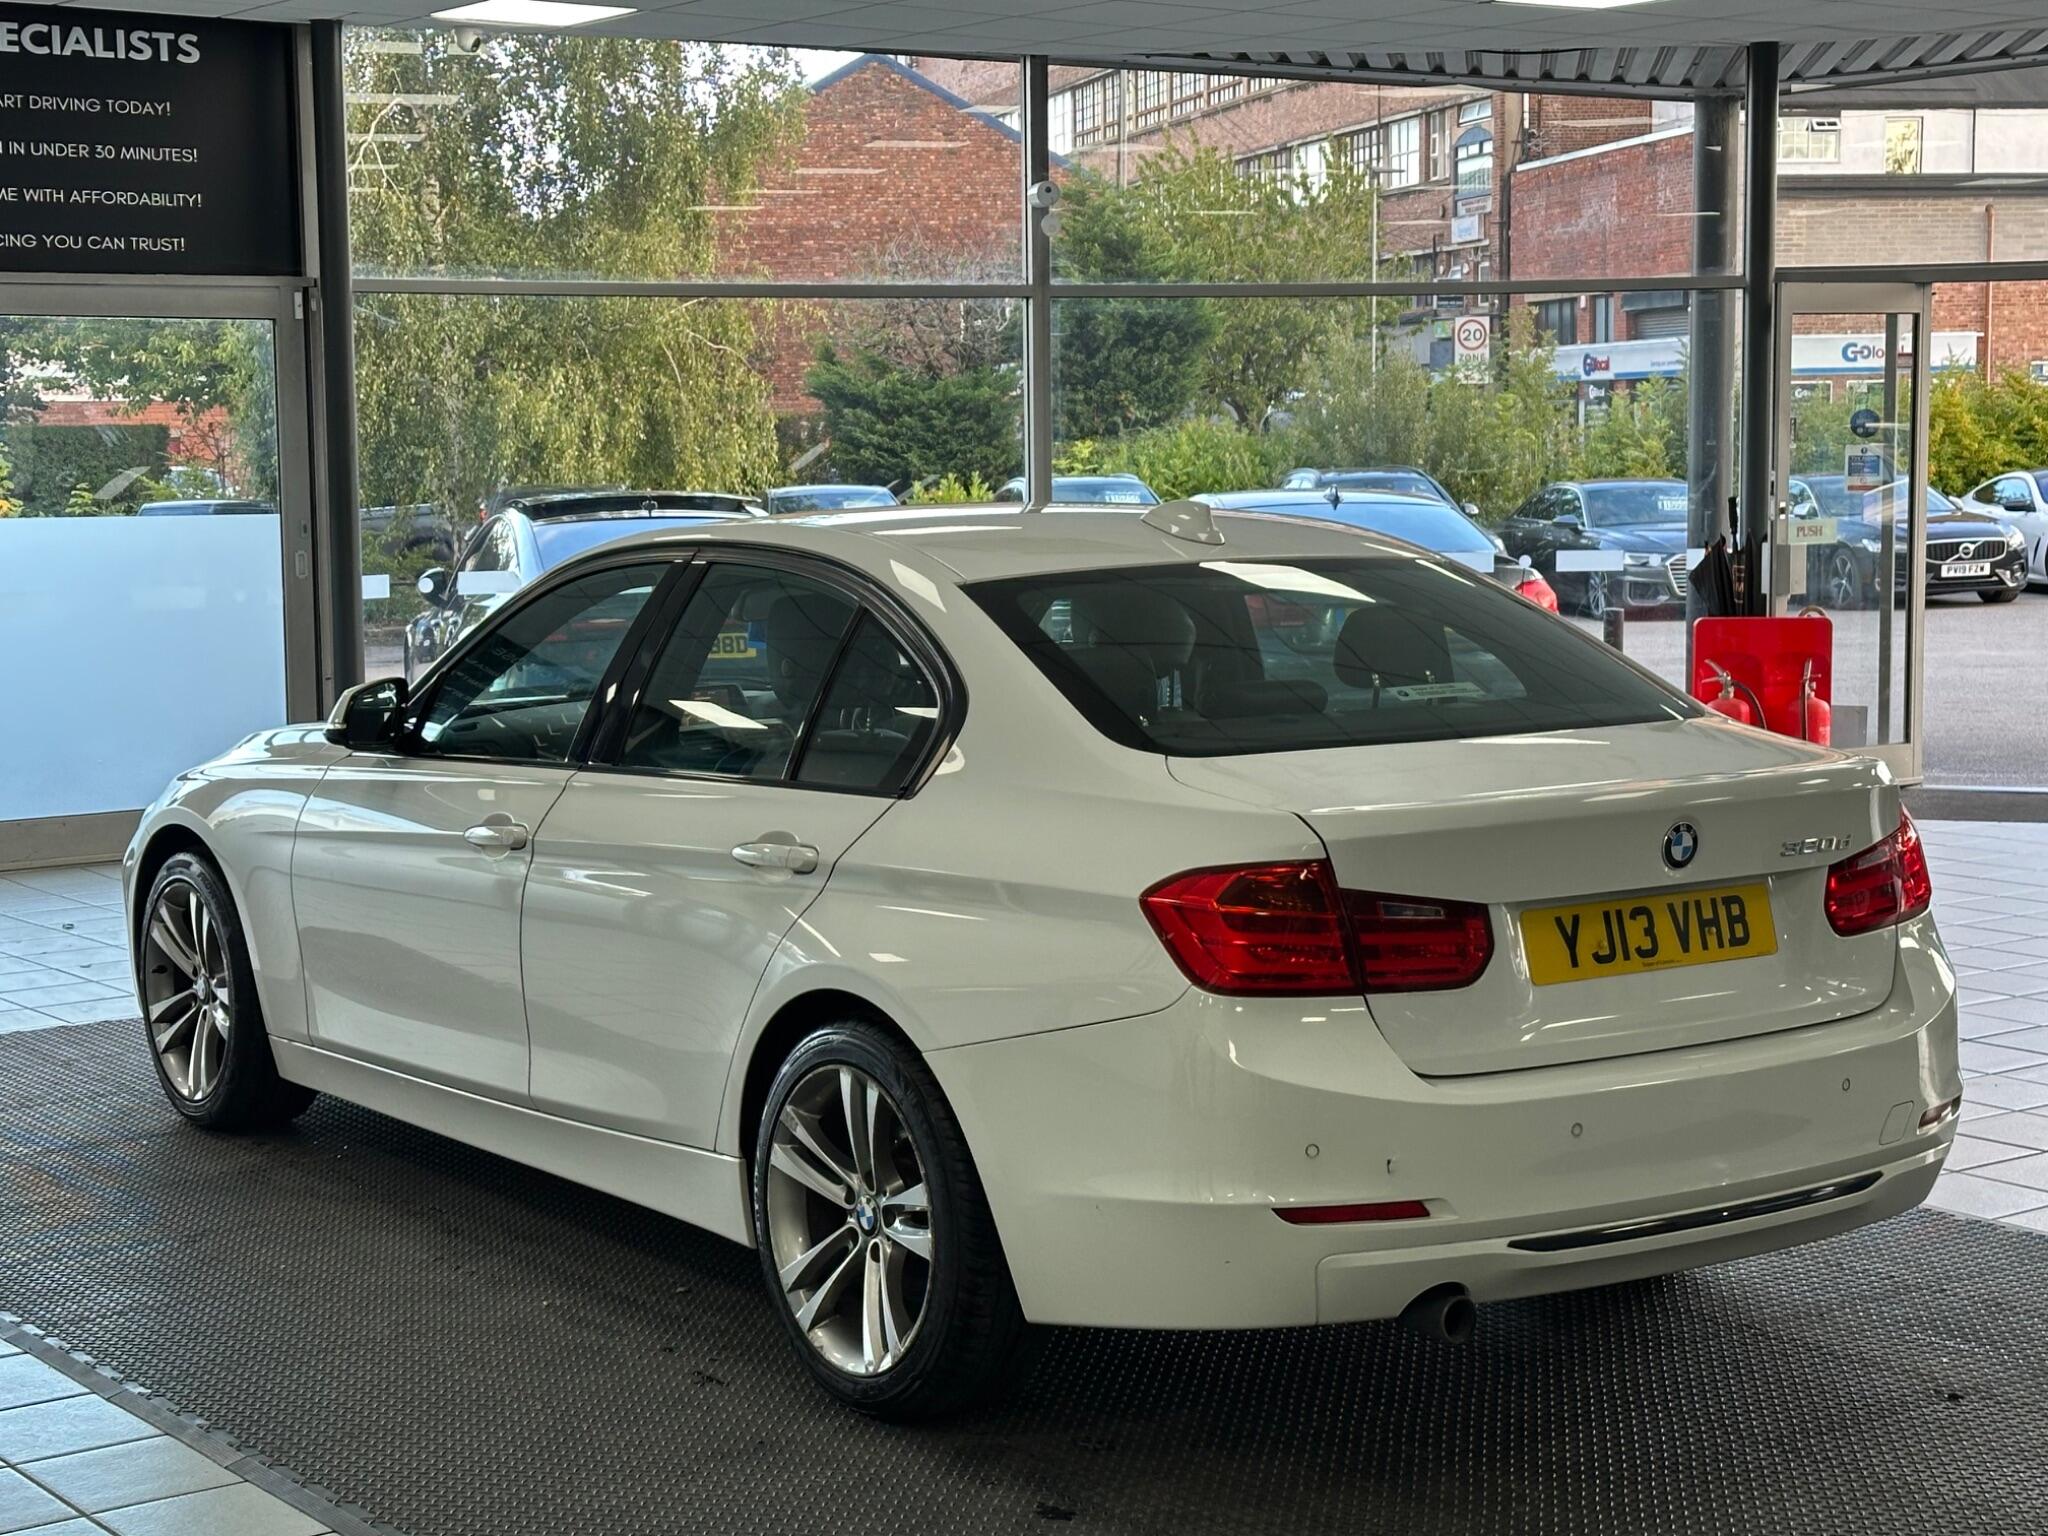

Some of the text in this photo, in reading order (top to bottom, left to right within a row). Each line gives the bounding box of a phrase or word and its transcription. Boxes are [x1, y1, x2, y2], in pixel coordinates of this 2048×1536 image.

[29, 95, 101, 112] DRIVING
[106, 99, 171, 116] TODAY!
[9, 141, 25, 155] IN
[30, 142, 90, 158] UNDER
[95, 145, 115, 159] 30
[120, 147, 198, 163] MINUTES!
[23, 188, 64, 203] WITH
[69, 190, 202, 208] AFFORDABILITY!
[42, 234, 82, 249] YOU
[87, 235, 124, 250] CAN
[130, 237, 185, 252] TRUST!
[1462, 328, 1483, 341] 20
[1459, 353, 1486, 361] ZONE
[1796, 525, 1823, 538] PUSH
[1554, 894, 1750, 969] YJ13 VHB
